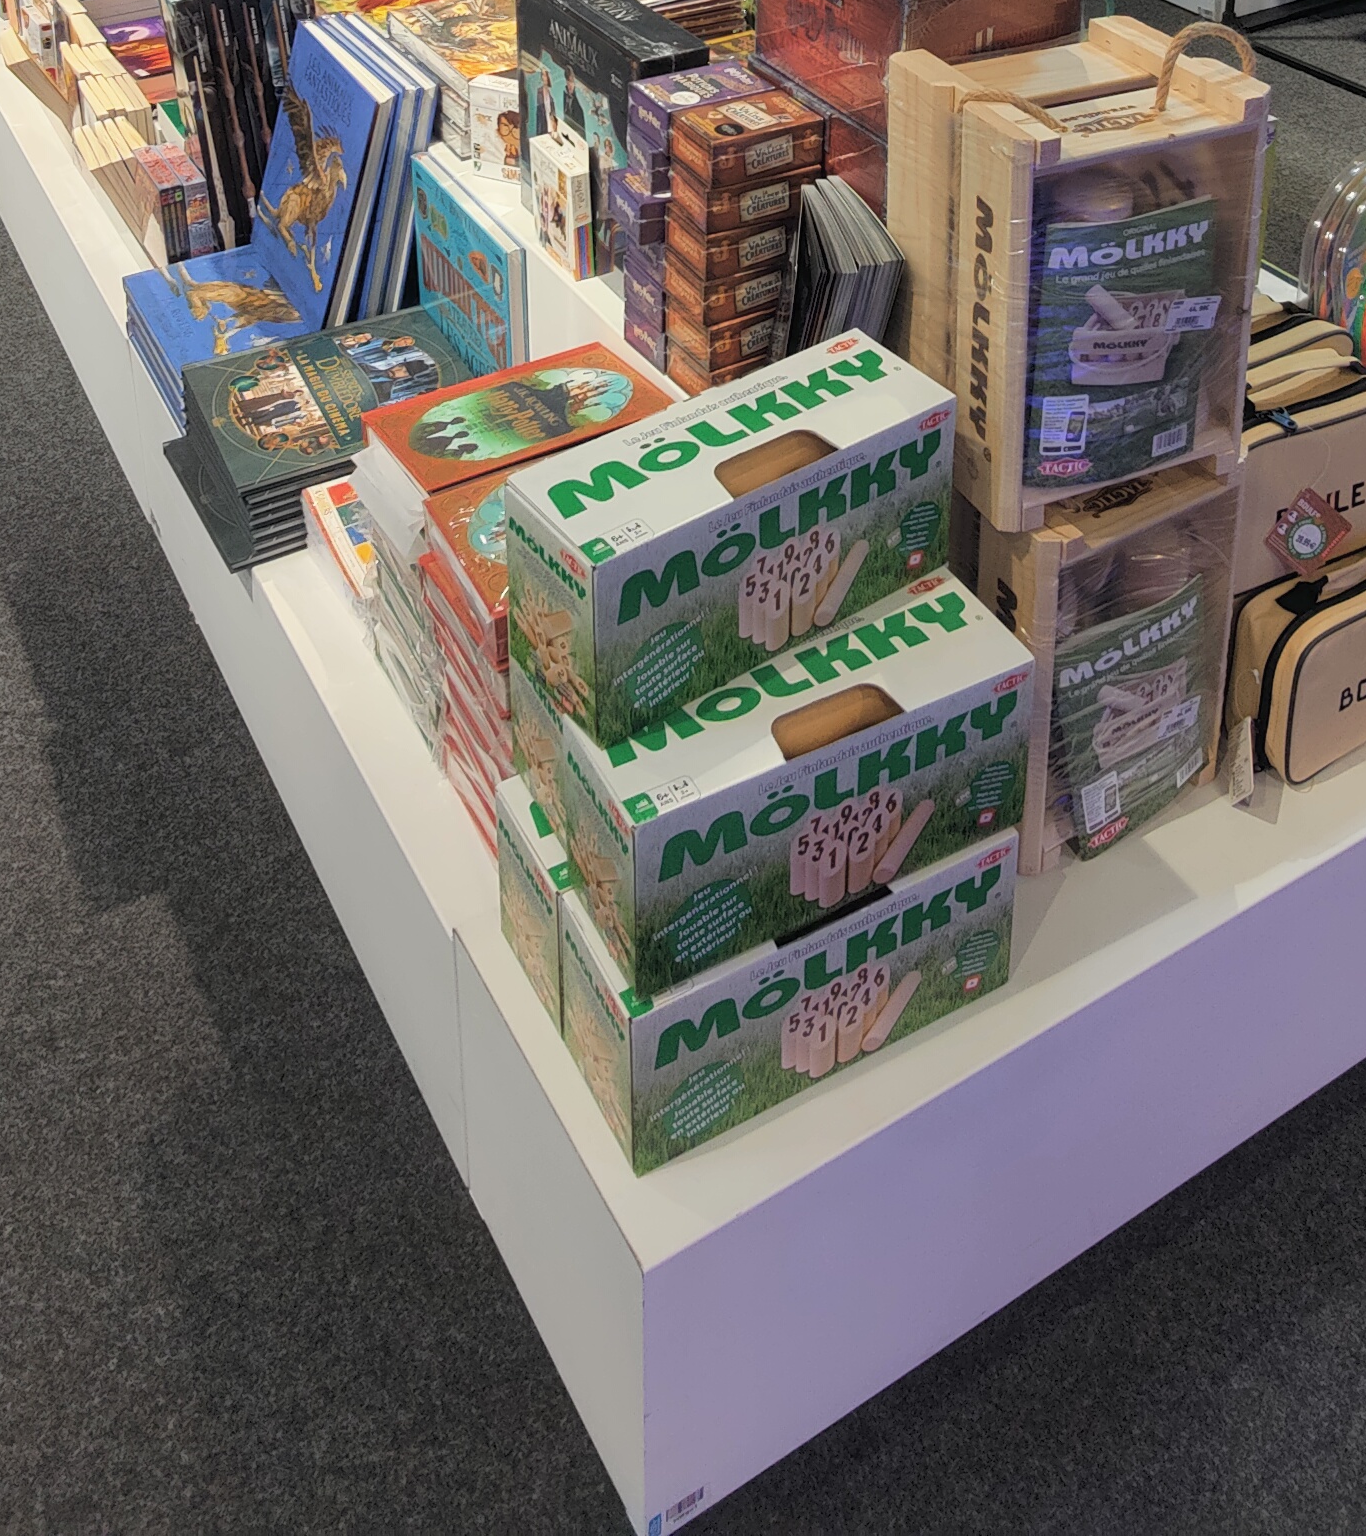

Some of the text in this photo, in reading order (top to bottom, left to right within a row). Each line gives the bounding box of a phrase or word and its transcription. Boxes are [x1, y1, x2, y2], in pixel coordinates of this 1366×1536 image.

[548, 18, 599, 68] ANIMAUX
[751, 148, 790, 169] CRÉATURES
[746, 194, 786, 213] CRÉATURES
[1123, 222, 1158, 237] ORIGINAL
[744, 240, 783, 260] CRÉATURES
[1048, 219, 1213, 270] MÖLKKY
[1056, 274, 1071, 285] Le
[1071, 272, 1100, 288] grand
[1101, 269, 1116, 286] jeu
[1117, 267, 1129, 280] de
[741, 284, 780, 306] CRÉATURES
[968, 194, 994, 442] MÖLKKY
[828, 338, 859, 354] TACTIC
[1093, 338, 1148, 351] MÖLKKY
[623, 434, 643, 447] Le
[663, 401, 720, 434] Finlandais
[920, 409, 951, 430] TACTIC
[547, 349, 885, 519] MÖLKKY
[1042, 458, 1088, 475] TACTIC
[708, 519, 724, 533] Le
[724, 512, 743, 532] Jeu
[744, 483, 799, 515] Finlandais
[617, 429, 941, 626] MÖLKKY
[509, 516, 587, 601] MÖLKKY
[907, 576, 945, 596] TACTIC
[1058, 595, 1198, 689] MÖLKKY
[993, 670, 1031, 695] TACTIC
[657, 688, 1019, 883] MÖLKKY
[566, 750, 629, 857] MÖLKKY
[1089, 817, 1129, 848] TACTIC
[977, 846, 1012, 868] TACTIC
[654, 863, 1002, 1070] MÖLKKY
